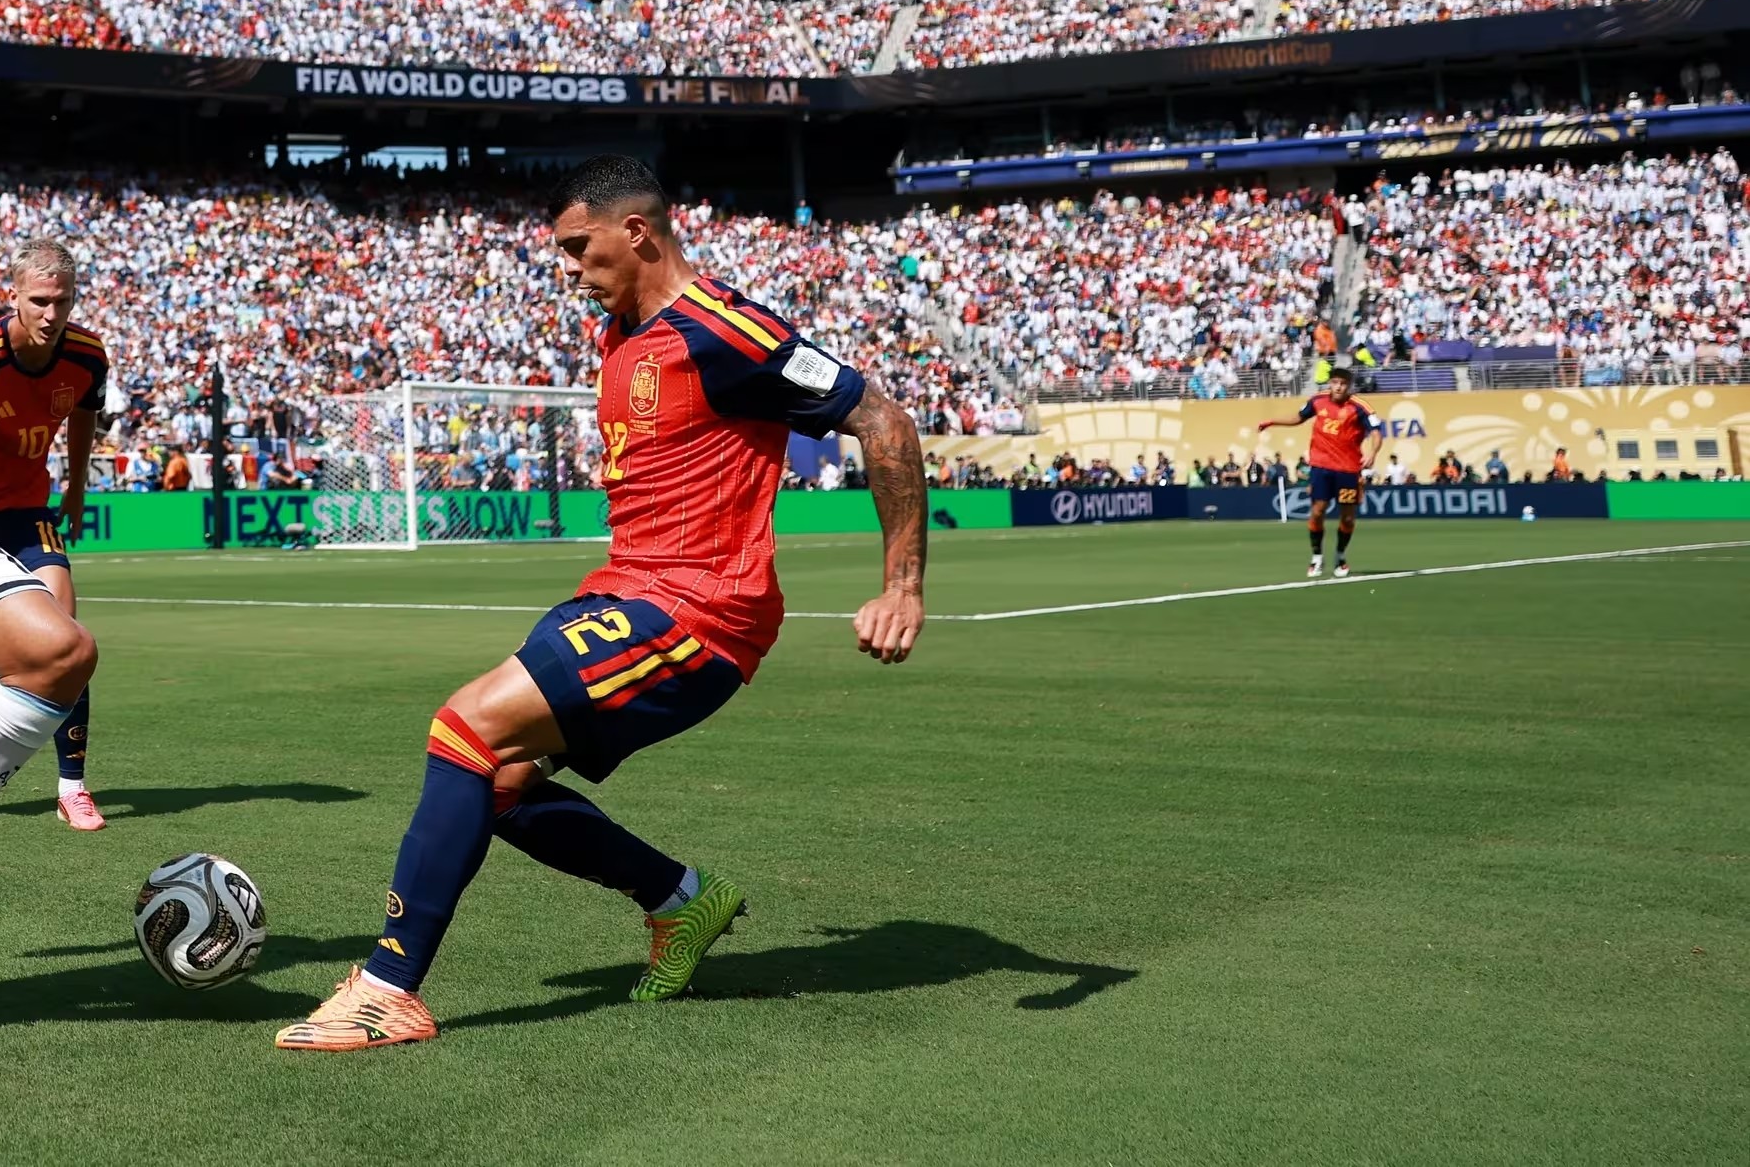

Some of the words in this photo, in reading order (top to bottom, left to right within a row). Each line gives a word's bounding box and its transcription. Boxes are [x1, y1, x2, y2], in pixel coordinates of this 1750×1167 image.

[296, 67, 359, 94] FIFA
[361, 69, 465, 98] WORLD
[468, 72, 525, 100] CUP
[528, 75, 627, 103] 2026
[1322, 418, 1340, 435] 22
[1367, 419, 1427, 439] IFA
[17, 425, 50, 460] 10
[1082, 491, 1154, 518] HYUNDAI
[1338, 488, 1358, 504] 22
